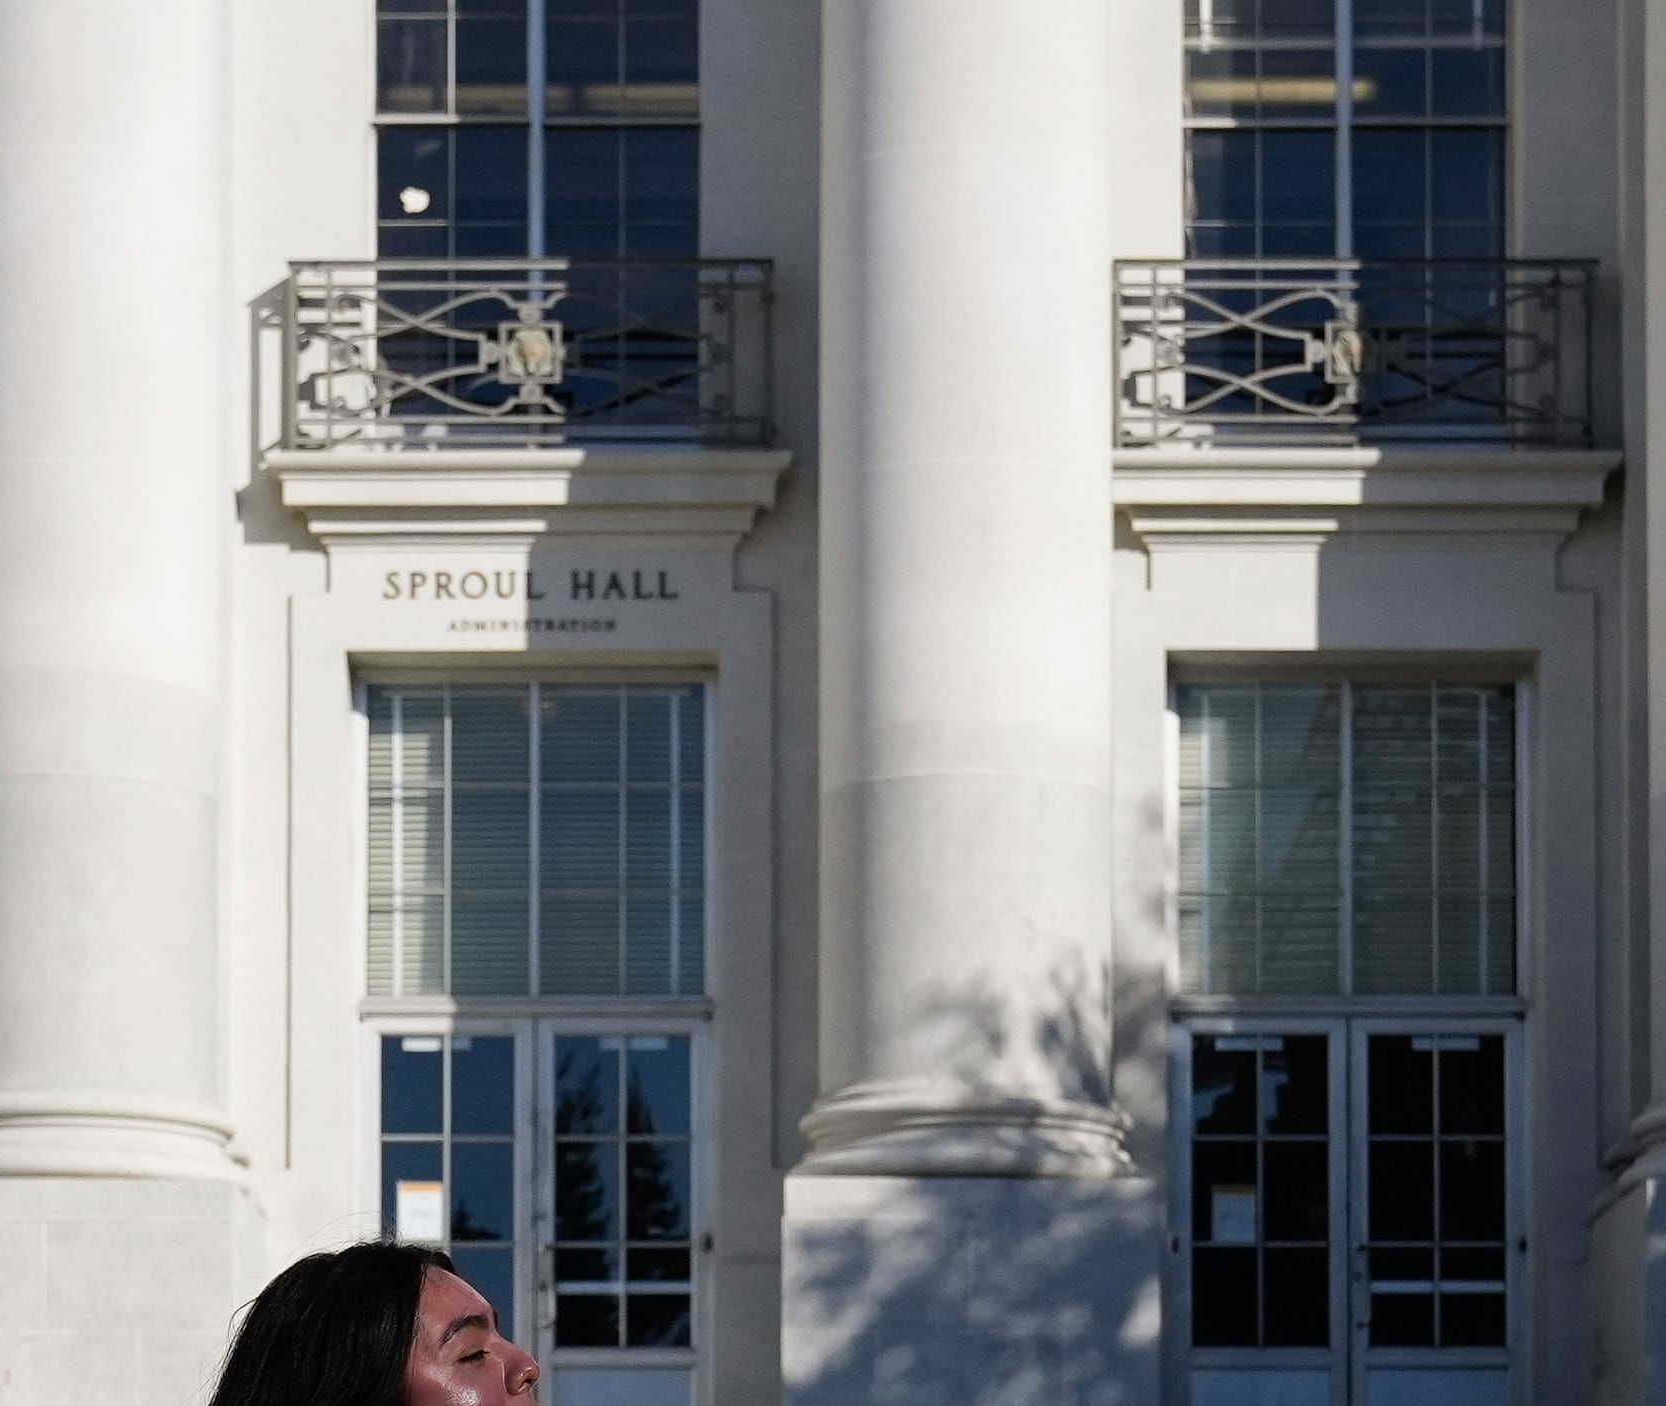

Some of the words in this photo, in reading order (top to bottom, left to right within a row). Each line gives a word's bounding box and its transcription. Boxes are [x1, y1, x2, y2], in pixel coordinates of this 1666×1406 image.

[382, 570, 546, 600] SPROUL
[571, 568, 680, 600] HALL
[447, 617, 617, 632] ADMINISTRATION
